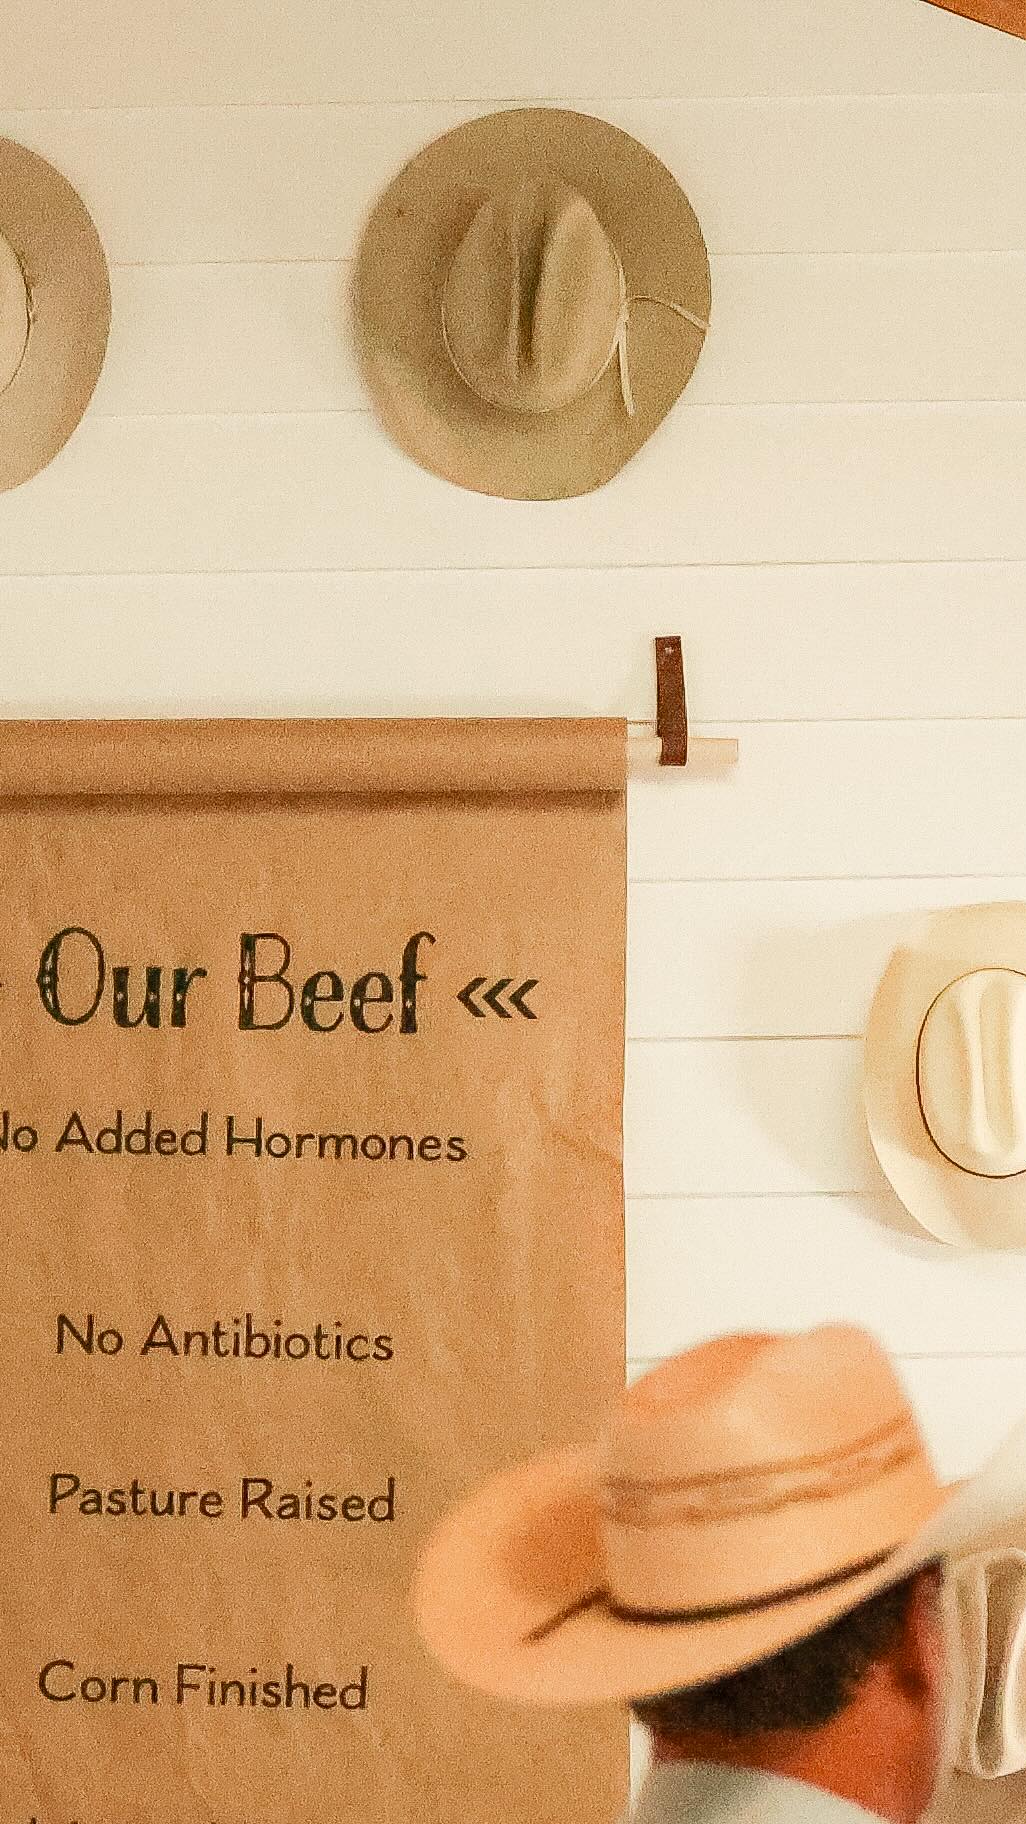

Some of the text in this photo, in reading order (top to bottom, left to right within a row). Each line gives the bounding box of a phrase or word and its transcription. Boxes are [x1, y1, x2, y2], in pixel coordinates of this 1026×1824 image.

[35, 926, 436, 1035] Our Beef
[0, 1109, 468, 1162] o Added Hormones
[56, 1313, 394, 1362] No Antibiotics
[49, 1473, 396, 1523] Pasture Raised
[38, 1659, 368, 1710] Corn Finished
